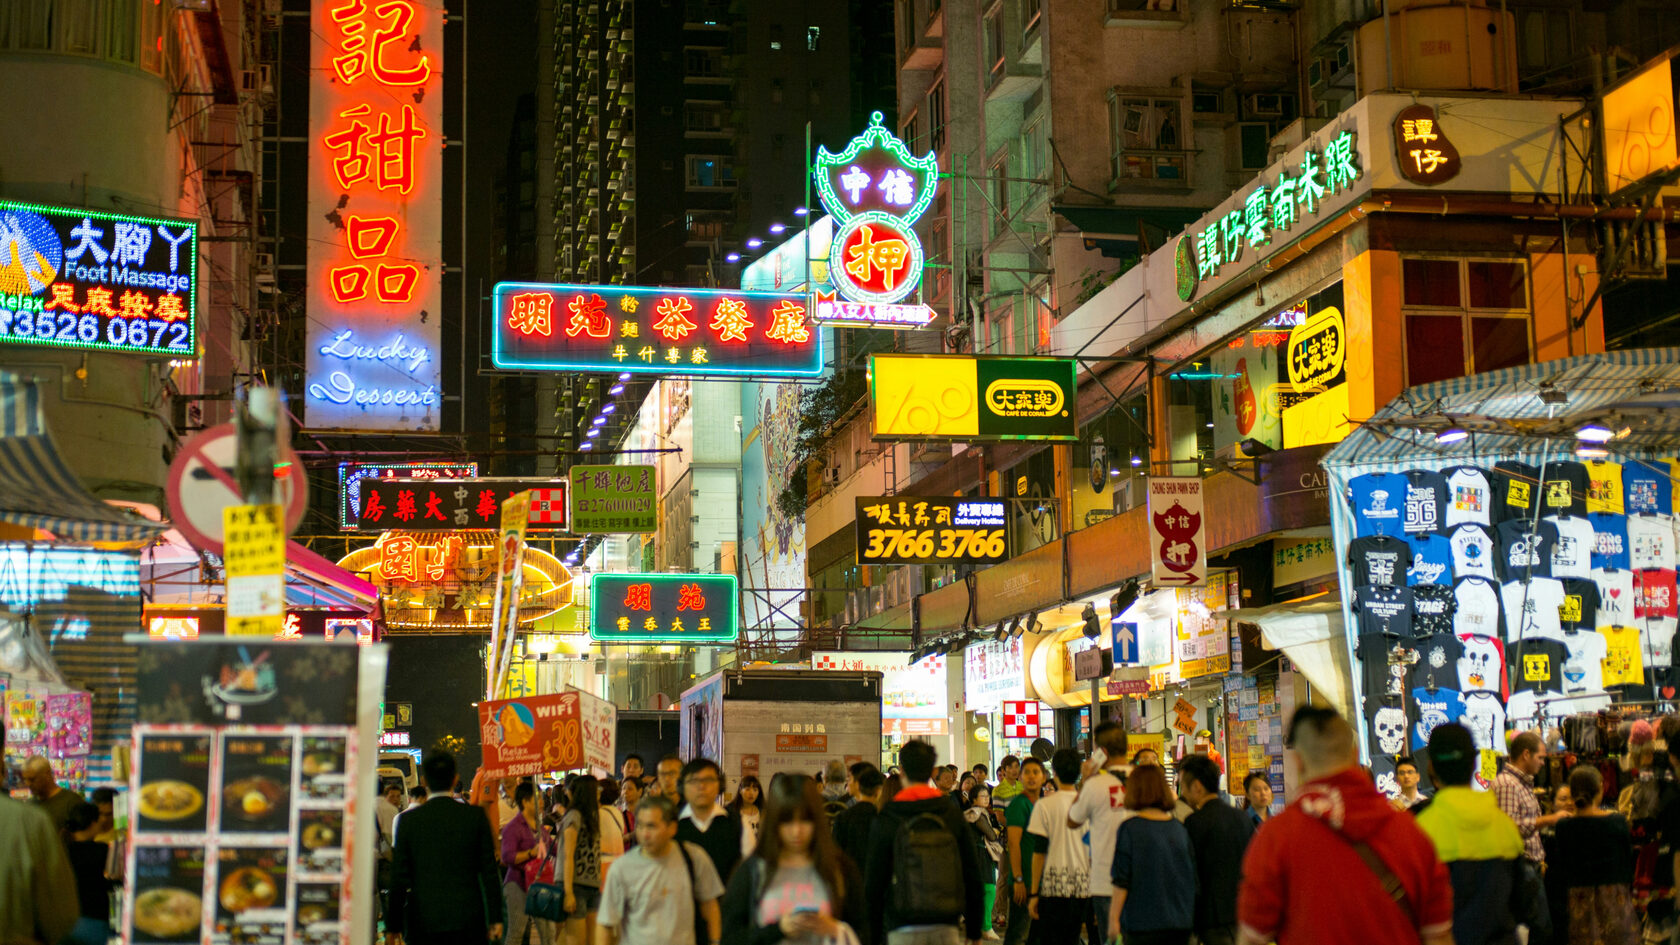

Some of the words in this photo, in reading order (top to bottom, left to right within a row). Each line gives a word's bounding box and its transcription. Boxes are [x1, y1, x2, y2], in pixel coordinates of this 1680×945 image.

[324, 0, 430, 303] 記甜品
[1402, 118, 1448, 174] 譚仔
[1197, 131, 1357, 282] 譚仔雲南米線
[65, 217, 192, 272] 大腳丫
[846, 225, 909, 291] 押
[64, 261, 110, 284] Foot
[110, 266, 190, 293] Massage
[44, 283, 188, 322] 足底按摩
[508, 292, 611, 338] 明苑
[652, 297, 811, 343] 茶餐廳
[14, 310, 100, 342] 3526
[106, 319, 189, 350] 0672
[318, 328, 431, 371] Lucky
[612, 344, 709, 364] 牛什專家
[309, 371, 436, 406] Dessert
[1189, 481, 1199, 494] SHOP
[591, 498, 651, 513] 27600029
[955, 518, 980, 526] Delivery
[1164, 515, 1190, 530] 中信
[864, 529, 934, 559] 3766
[936, 529, 1005, 559] 3766
[1166, 540, 1191, 566] 押
[624, 583, 705, 612] 明苑
[616, 616, 712, 632] 雲吞大王
[584, 719, 610, 749] $48
[1175, 717, 1194, 733] less
[542, 718, 580, 770] $38
